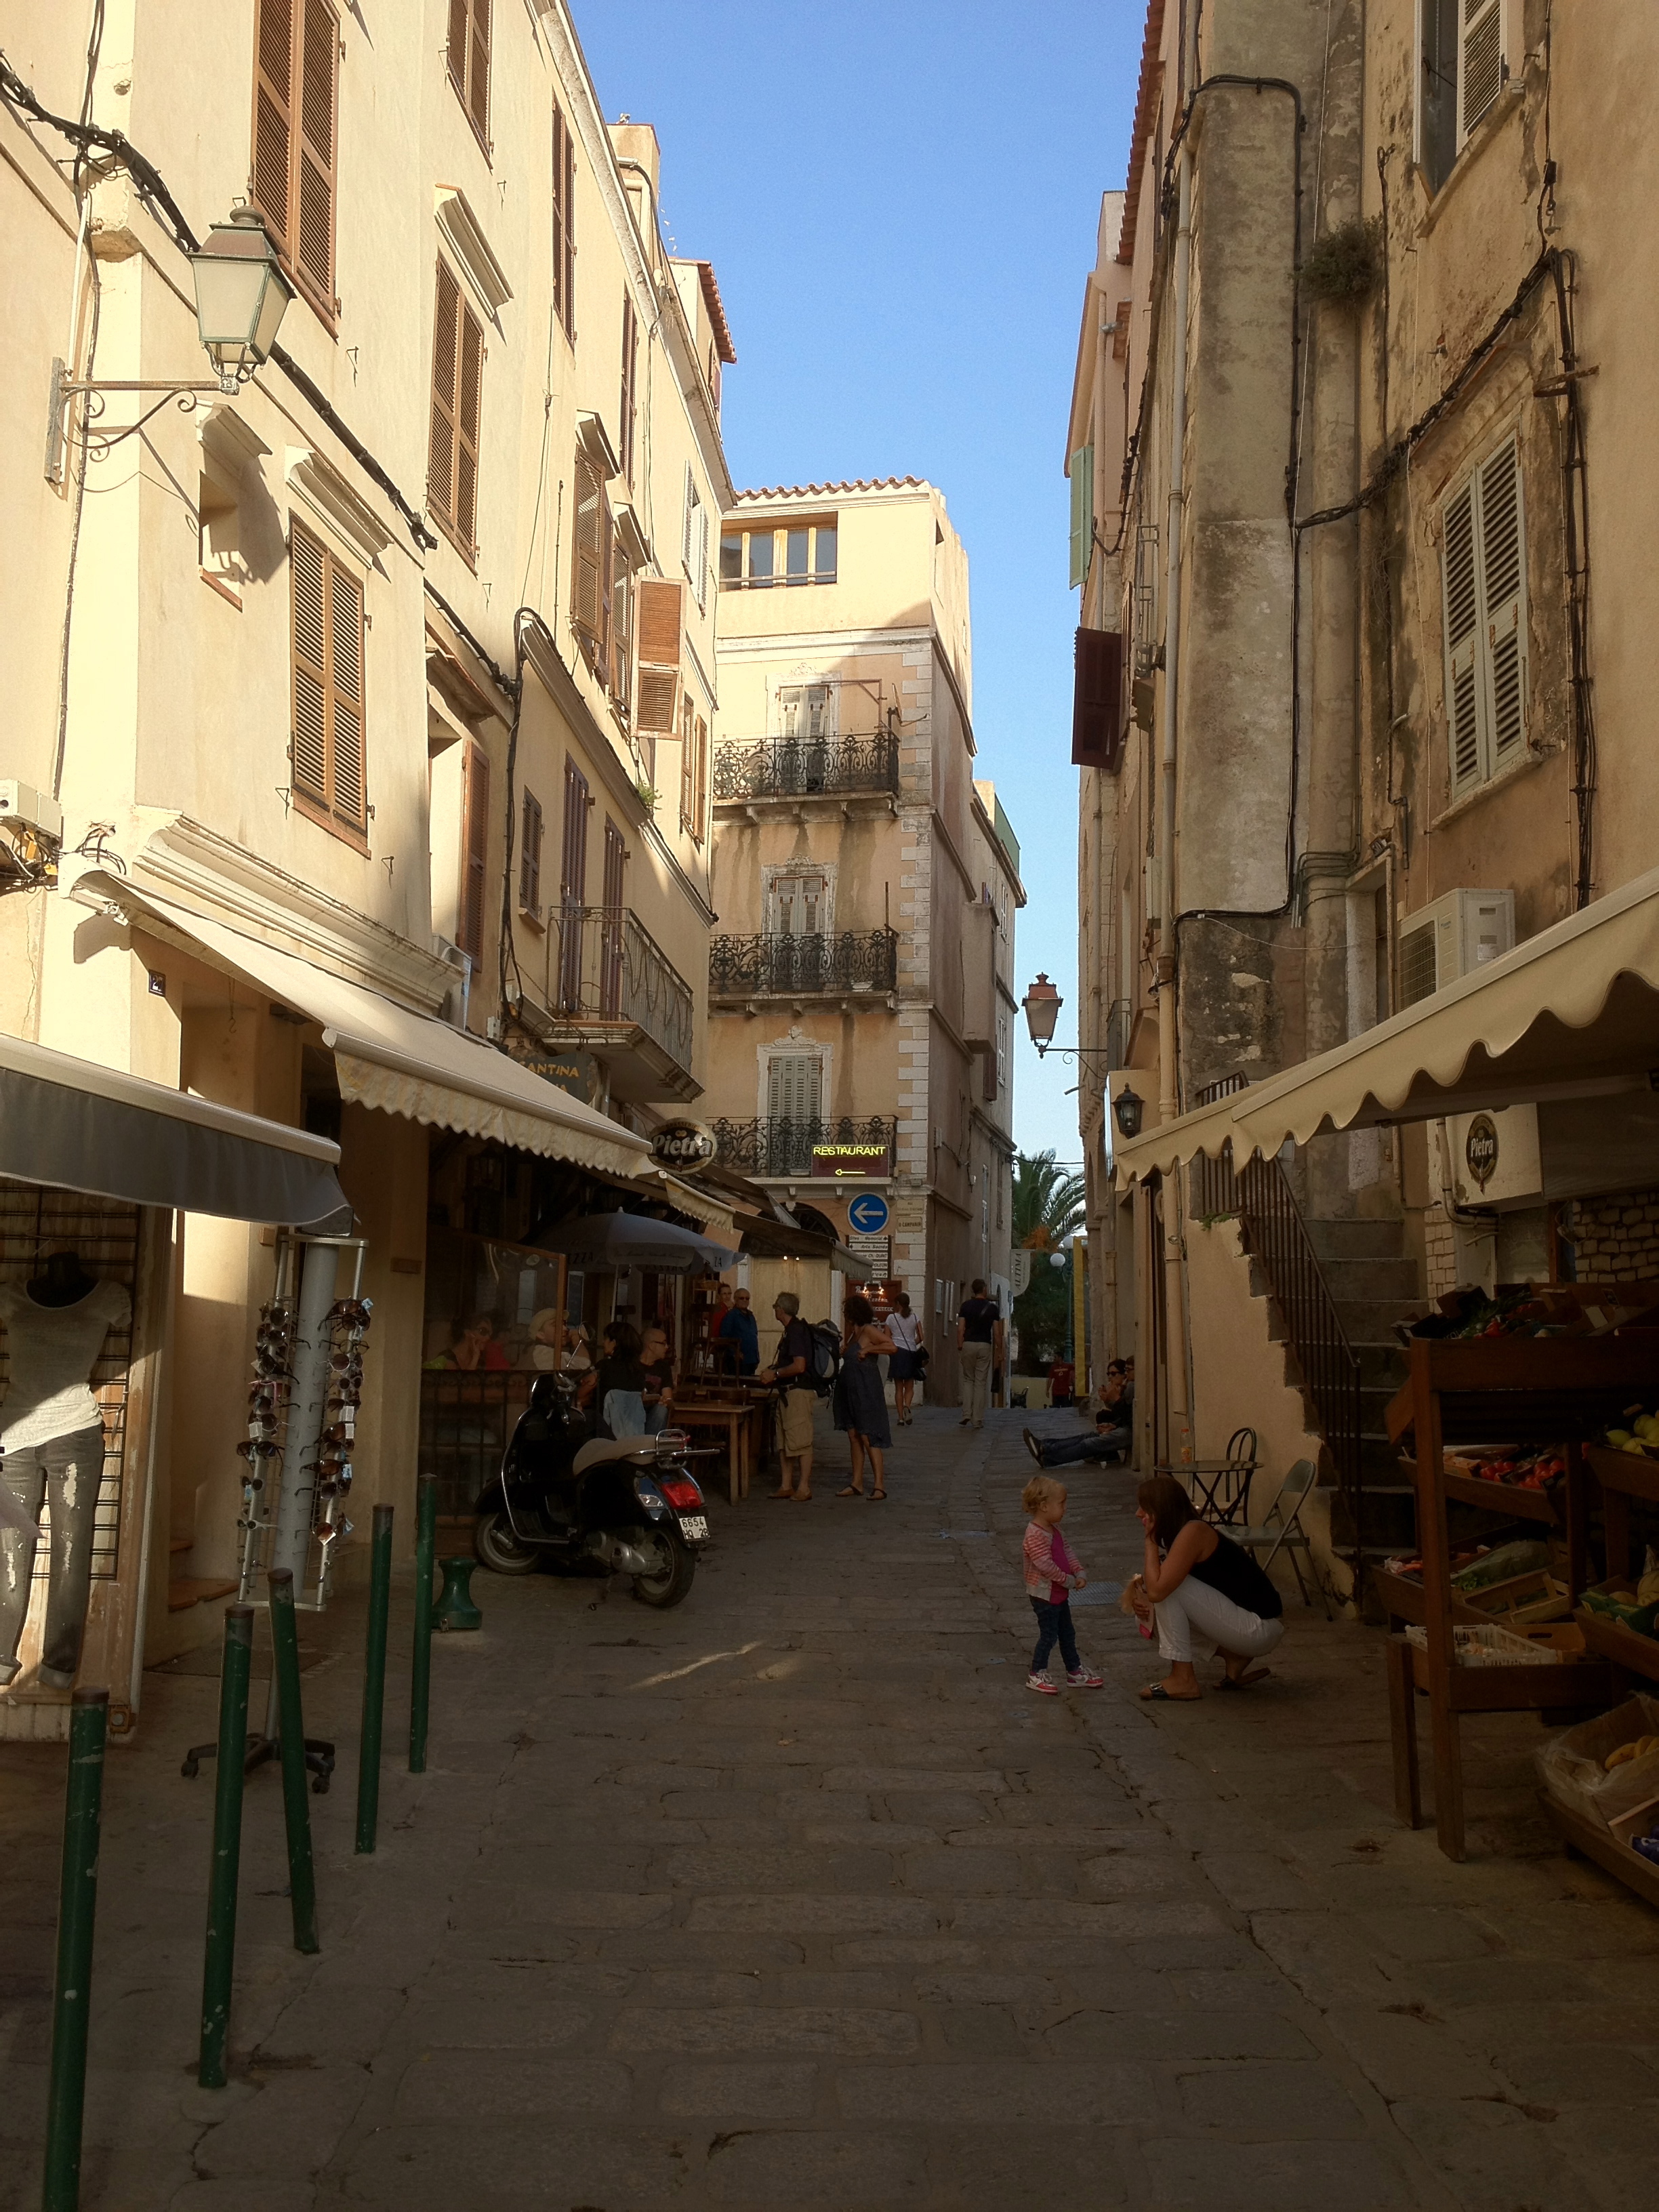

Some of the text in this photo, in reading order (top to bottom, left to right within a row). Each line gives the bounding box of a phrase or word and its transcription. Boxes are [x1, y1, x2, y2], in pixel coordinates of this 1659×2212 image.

[652, 1134, 712, 1157] Pietra
[813, 1146, 886, 1155] RESTAURANT
[1470, 1137, 1494, 1158] Pietra
[682, 1517, 704, 1528] 6654
[699, 1528, 710, 1538] 2B
